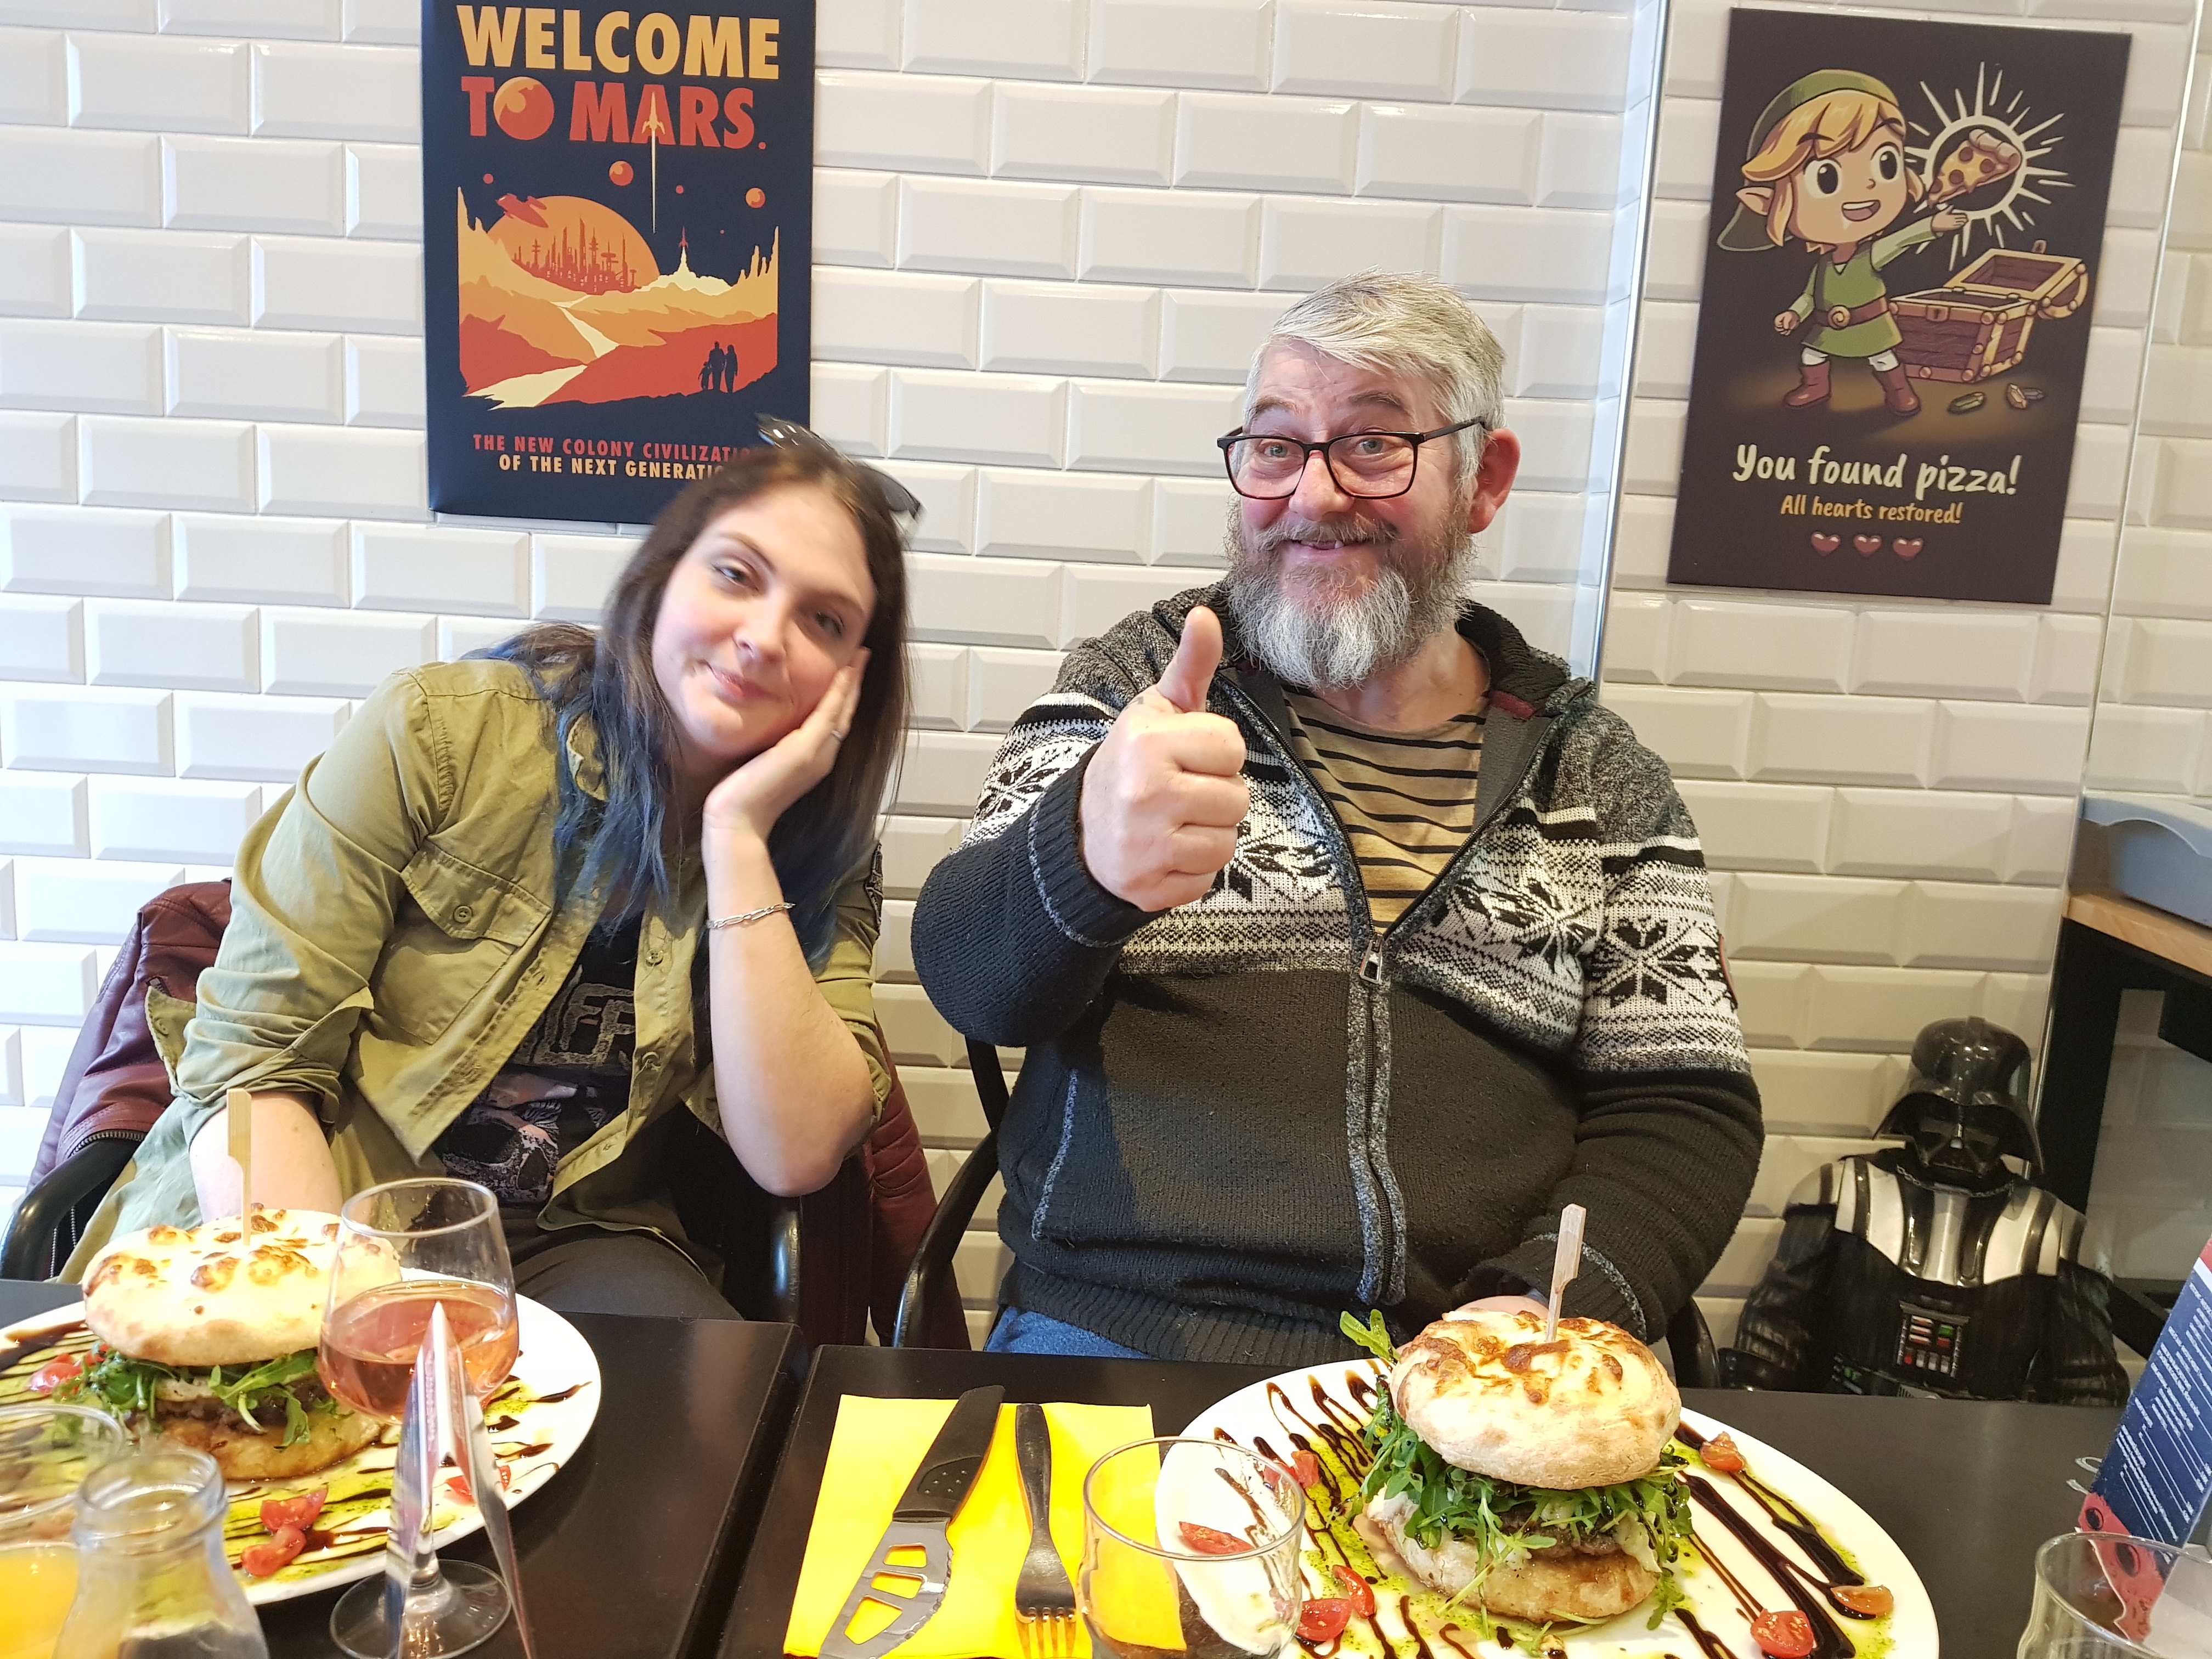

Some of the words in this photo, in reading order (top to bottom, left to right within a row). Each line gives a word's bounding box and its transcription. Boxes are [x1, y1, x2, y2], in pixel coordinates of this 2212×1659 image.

[456, 5, 780, 80] WELCOME
[461, 76, 555, 140] TO
[569, 81, 767, 149] MARS.
[473, 434, 505, 452] THE
[514, 436, 554, 454] NEW
[562, 438, 635, 459] COLONY
[499, 454, 521, 471] OF
[530, 456, 562, 473] THE
[571, 458, 617, 476] NEXT
[1732, 444, 1796, 482] You
[1808, 445, 1908, 488] found
[1915, 454, 2023, 501] pizza!
[1780, 494, 1807, 516] All
[1812, 496, 1873, 520] hearts
[1879, 502, 1964, 524] restored!
